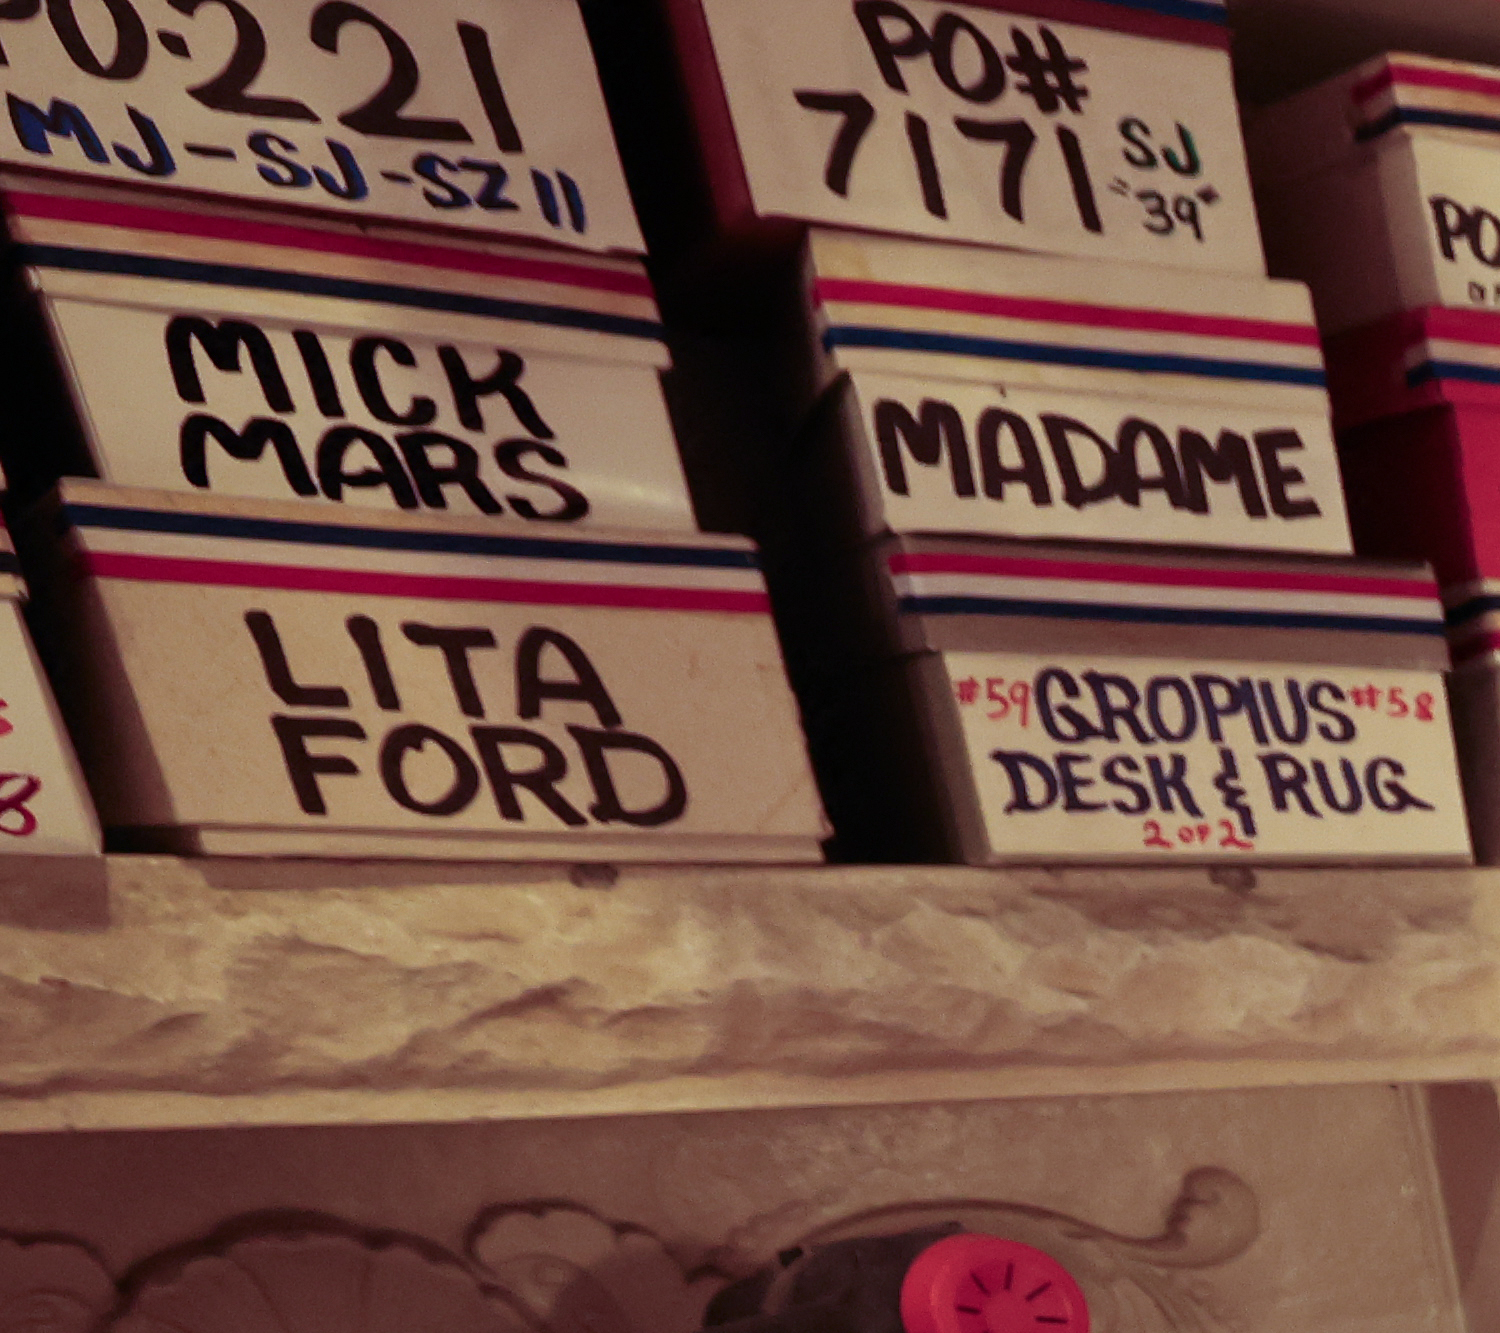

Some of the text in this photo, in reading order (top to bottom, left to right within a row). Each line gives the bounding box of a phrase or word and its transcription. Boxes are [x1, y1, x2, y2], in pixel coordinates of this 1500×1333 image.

[853, 0, 1089, 115] PO#
[793, 89, 1104, 235] 7171
[1118, 117, 1201, 177] SJ
[165, 316, 556, 440] MICK
[179, 415, 590, 522] MARS
[873, 398, 1323, 521] MADAME
[245, 610, 623, 728] LITA
[1035, 666, 1358, 746] GROPIUS
[272, 715, 688, 829] FORD
[989, 749, 1205, 818] DESK
[1257, 752, 1436, 818] RUG
